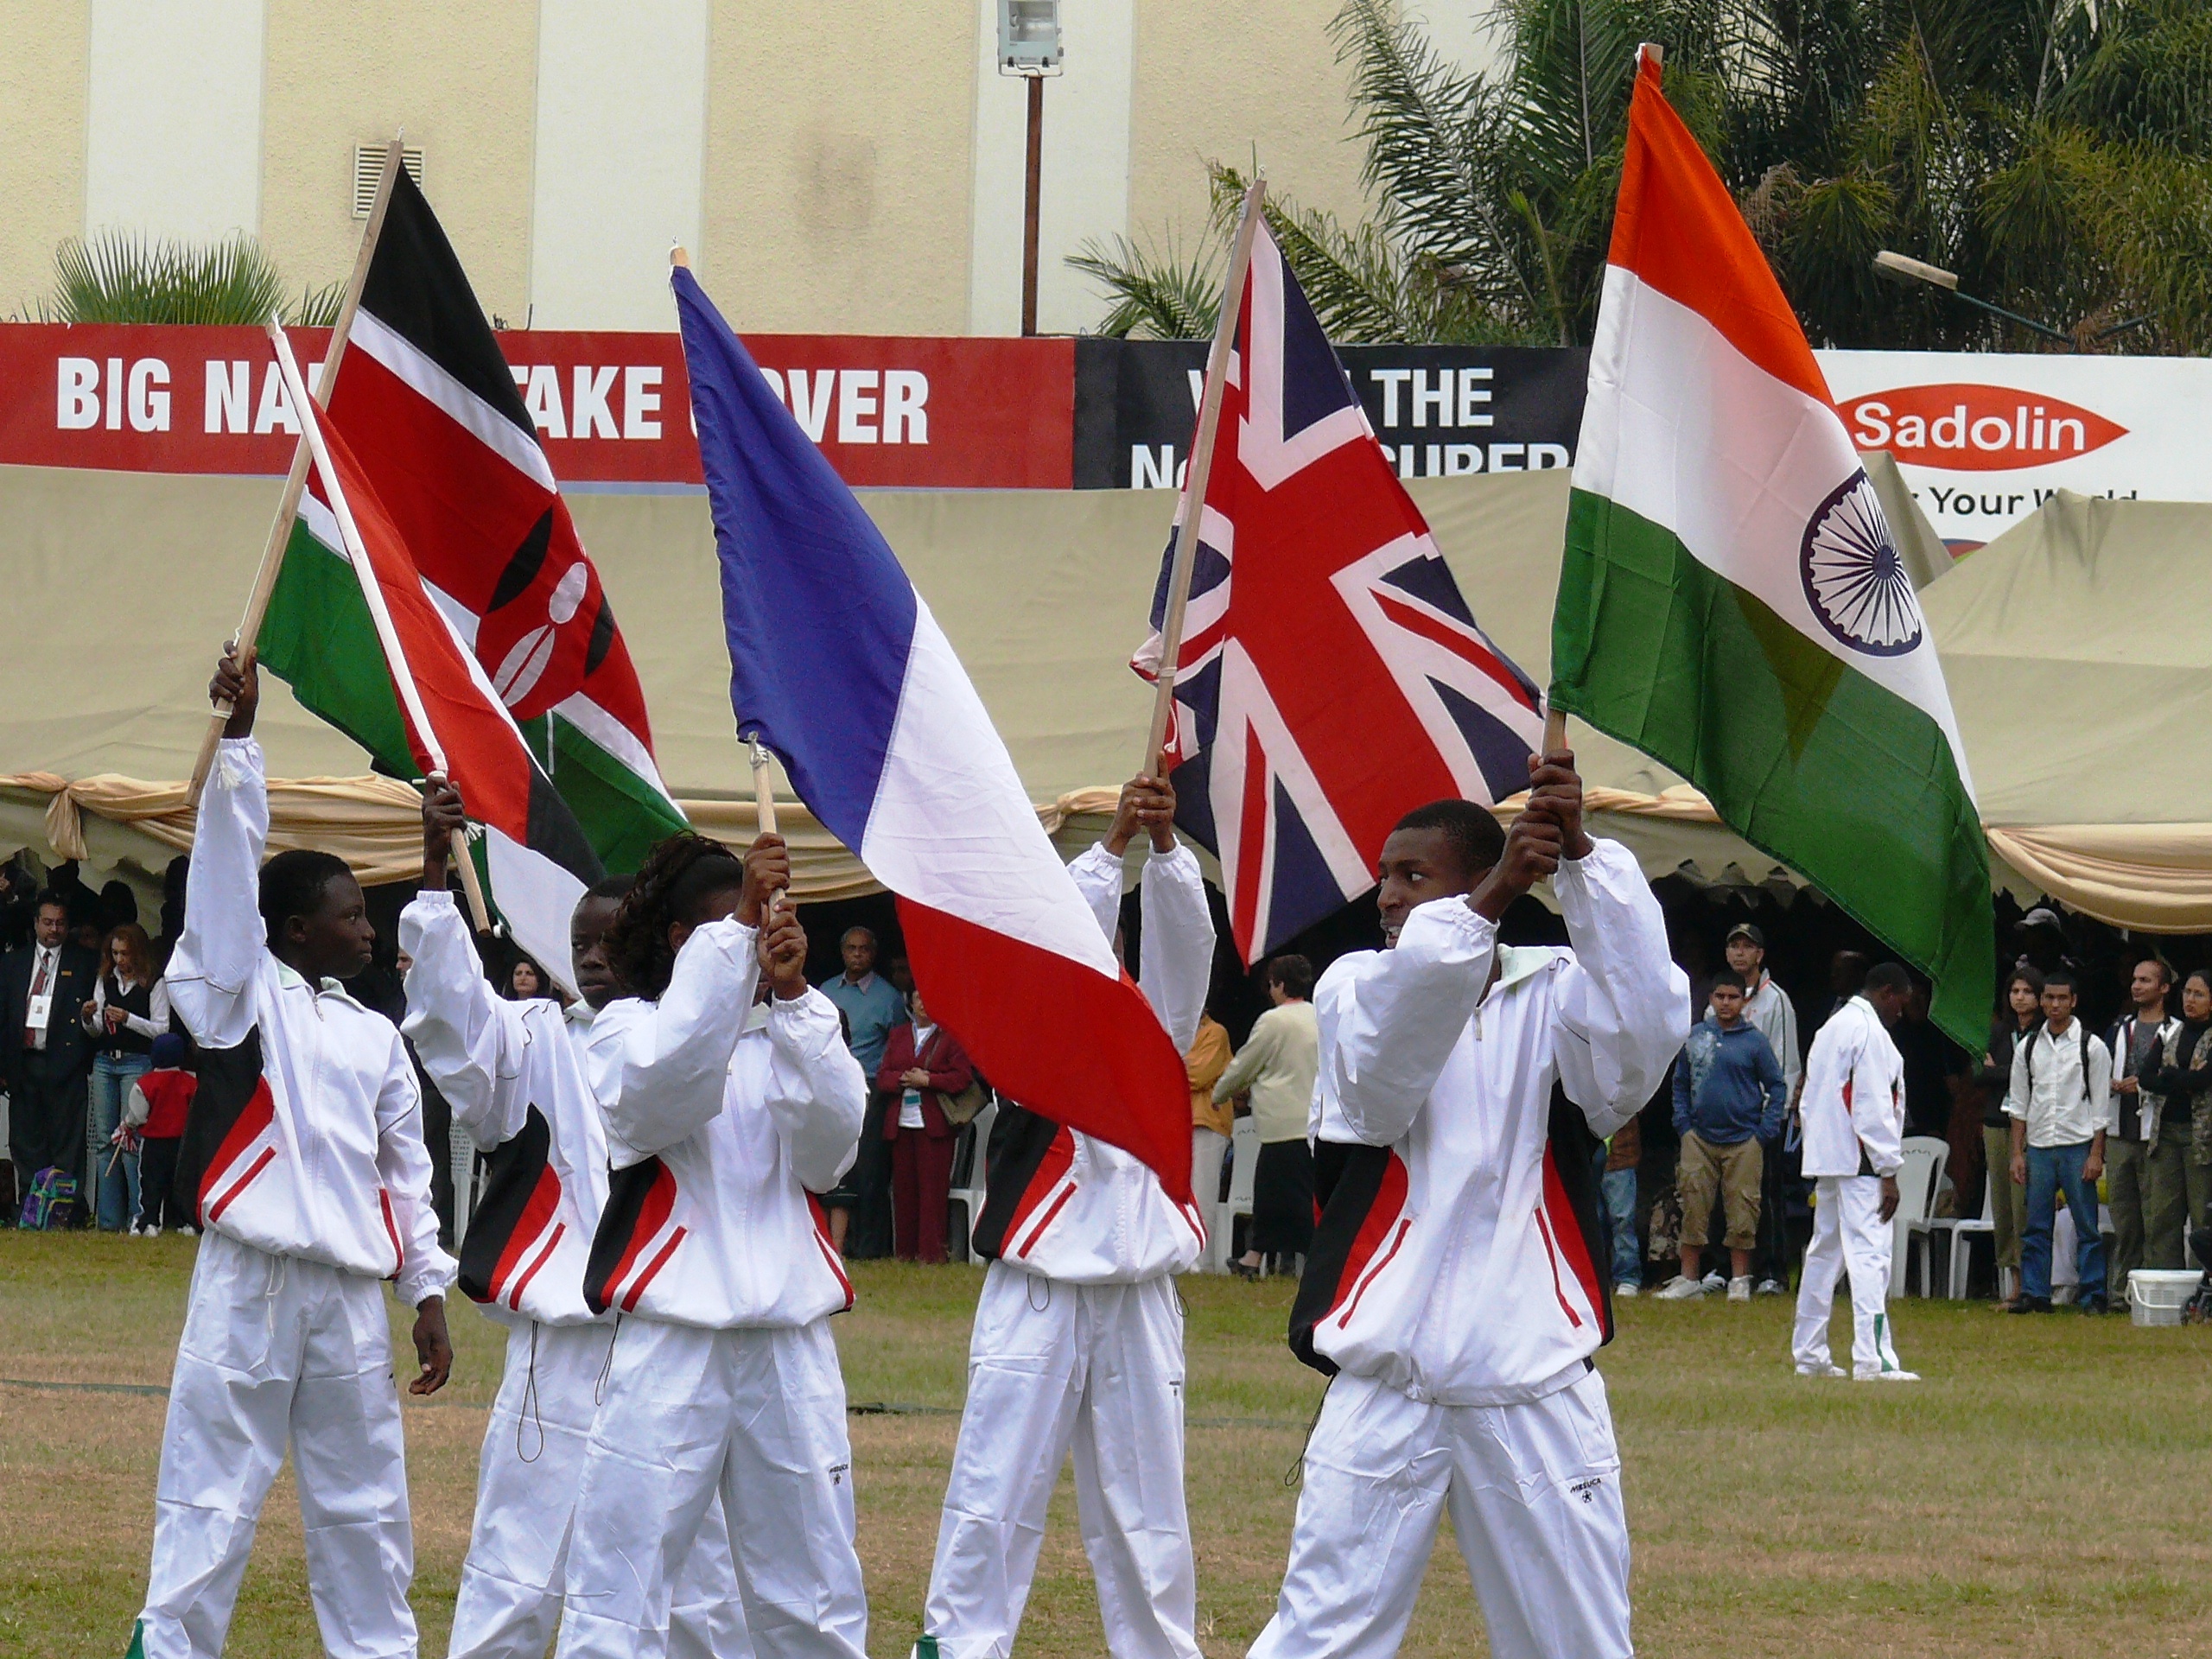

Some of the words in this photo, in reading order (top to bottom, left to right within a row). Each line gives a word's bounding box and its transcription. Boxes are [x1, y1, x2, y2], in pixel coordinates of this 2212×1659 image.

[57, 357, 170, 432] BIG
[204, 359, 327, 434] NA
[690, 368, 930, 444] VER
[1370, 368, 1494, 428] THE
[1853, 401, 2085, 451] Sadolin
[1929, 486, 2024, 516] Your
